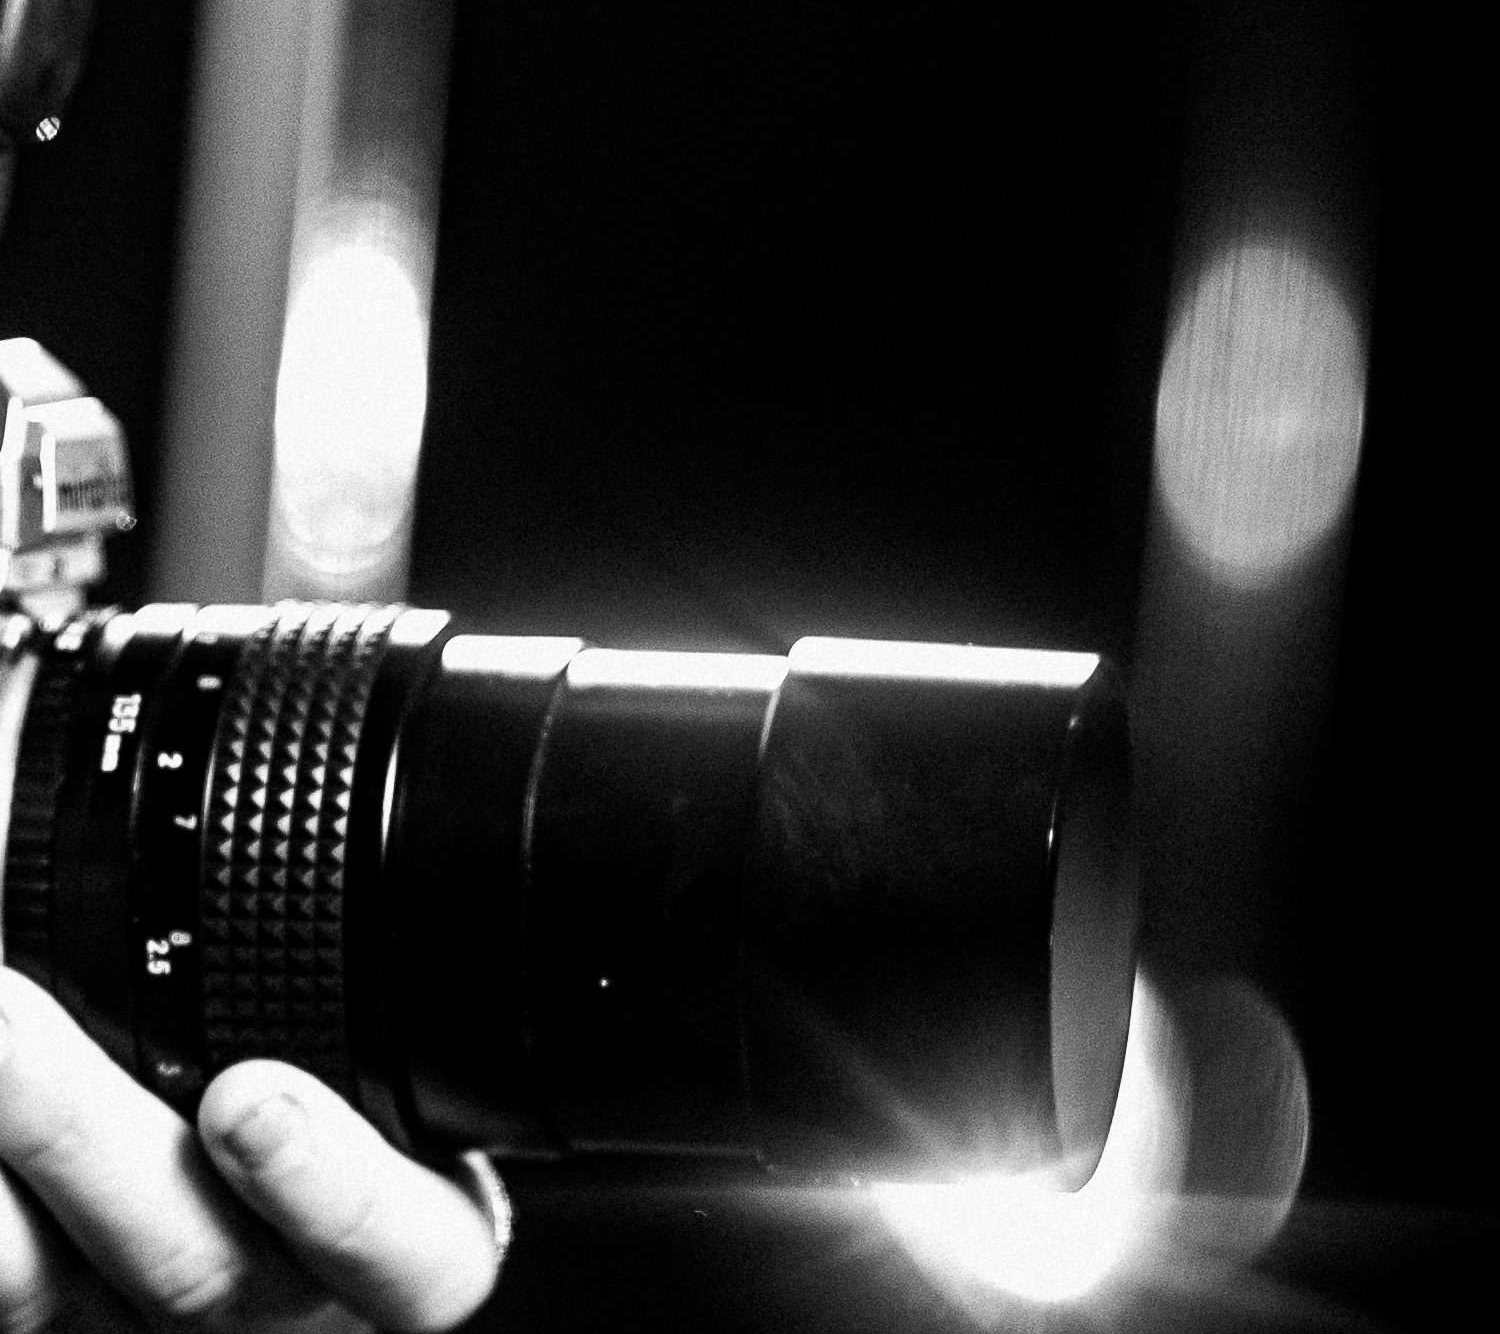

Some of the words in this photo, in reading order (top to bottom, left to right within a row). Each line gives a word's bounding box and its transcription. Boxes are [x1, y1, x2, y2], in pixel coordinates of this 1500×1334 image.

[157, 752, 183, 769] 2
[175, 813, 197, 831] 7
[145, 938, 172, 975] 2.5
